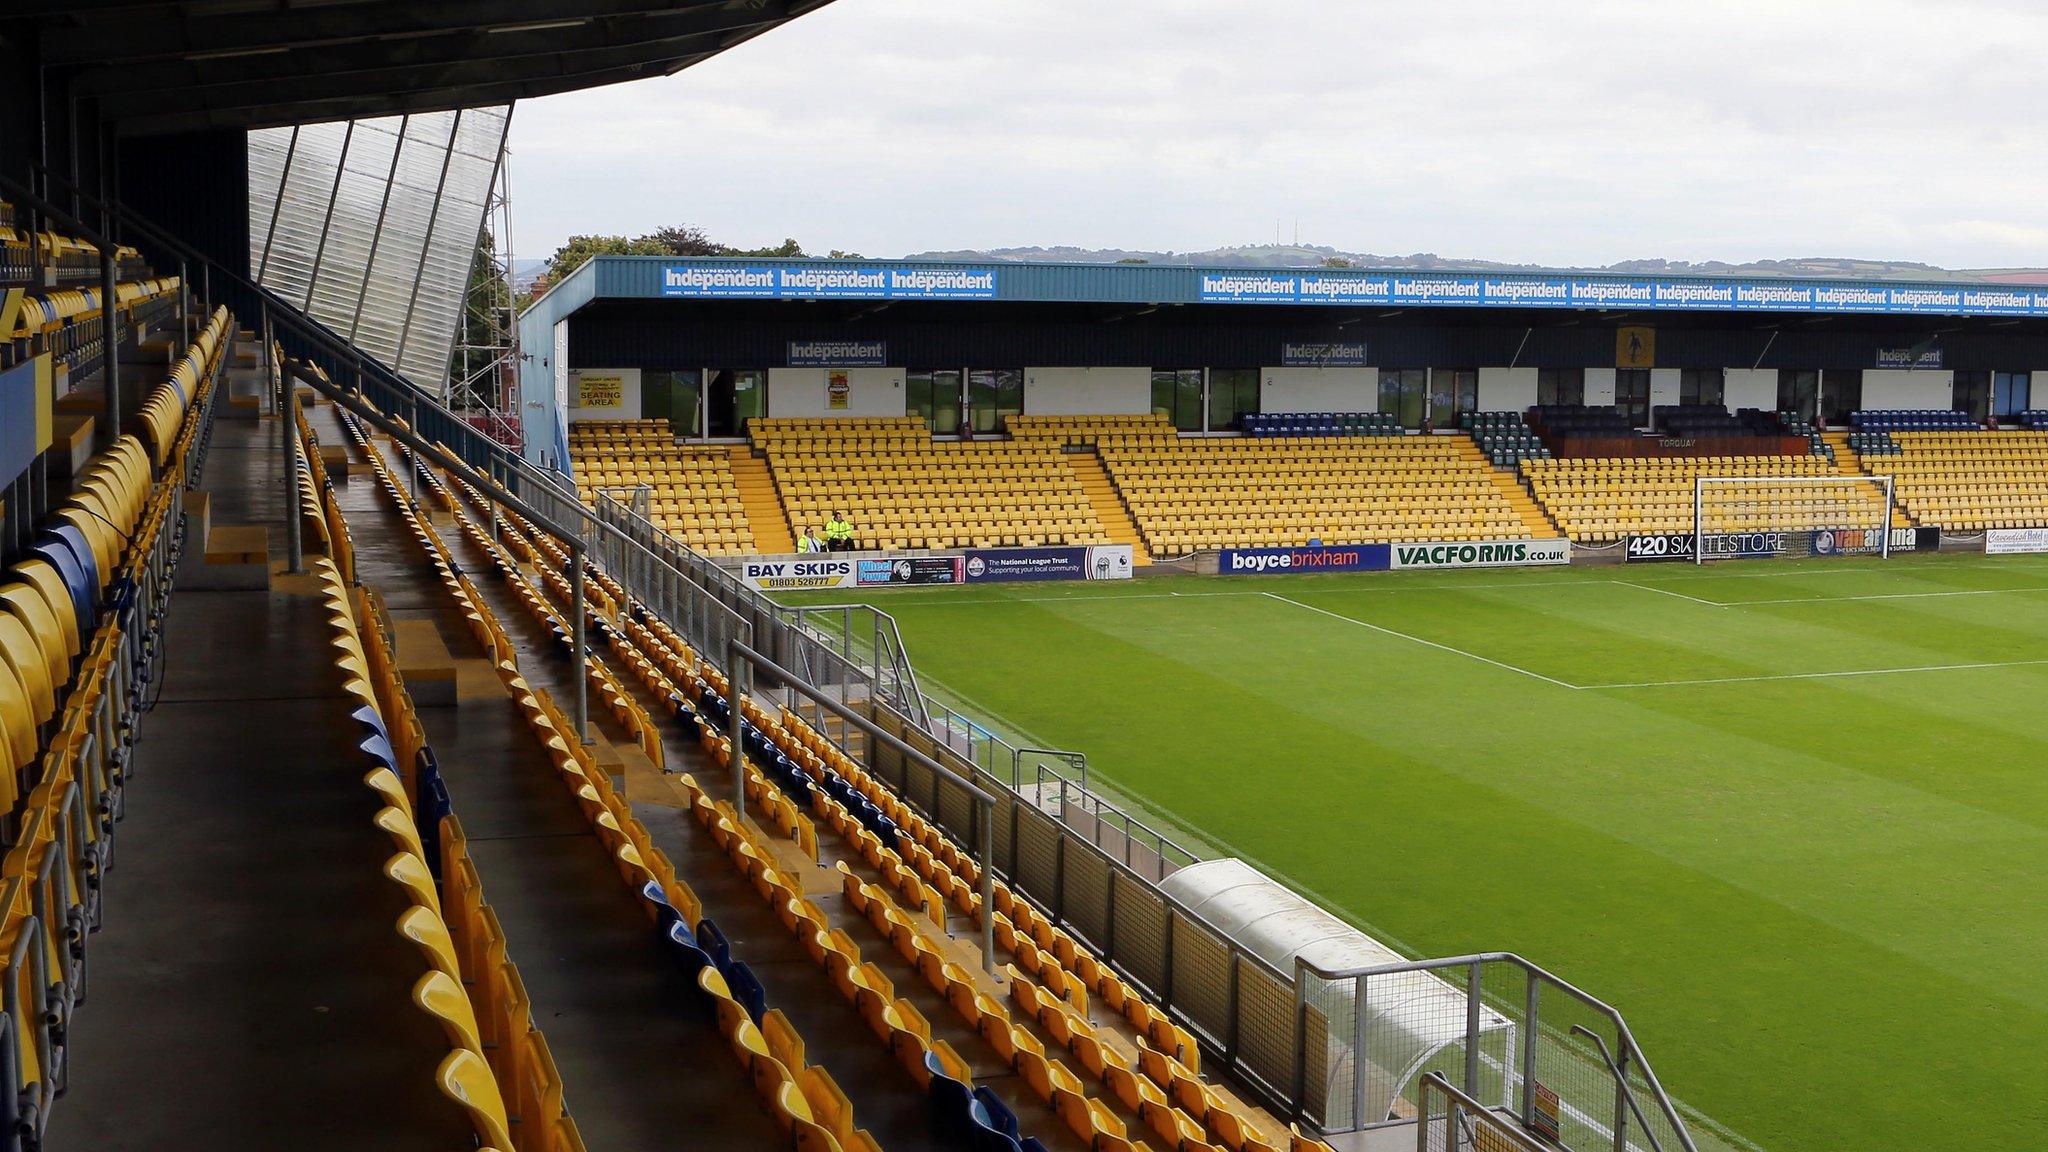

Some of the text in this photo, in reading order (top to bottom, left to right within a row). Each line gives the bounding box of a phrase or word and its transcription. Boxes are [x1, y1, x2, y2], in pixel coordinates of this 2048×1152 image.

[666, 268, 774, 290] Independent
[781, 270, 884, 291] Independent
[892, 272, 992, 292] Independent
[1203, 276, 1295, 296] Independent
[1300, 278, 1389, 298] Independent
[1394, 280, 1480, 300] Independent
[1484, 281, 1567, 300] Independent
[1572, 283, 1651, 302] Independent
[1656, 284, 1732, 303] Independent
[1737, 286, 1811, 304] Independent
[1815, 288, 1886, 306] Independent
[1891, 290, 1960, 308] Independent
[1964, 292, 2030, 309] Independent
[792, 342, 882, 360] Independent
[1659, 439, 1696, 448] TORQUAY
[1629, 533, 1788, 555] 420 SKTESTORE
[748, 562, 850, 577] BAY SKIPS
[858, 560, 892, 570] Wheel
[988, 566, 1022, 575] Supporting
[1049, 565, 1080, 573] community
[1029, 558, 1050, 566] League
[769, 578, 829, 586] 01803 526777
[858, 572, 892, 582] Power
